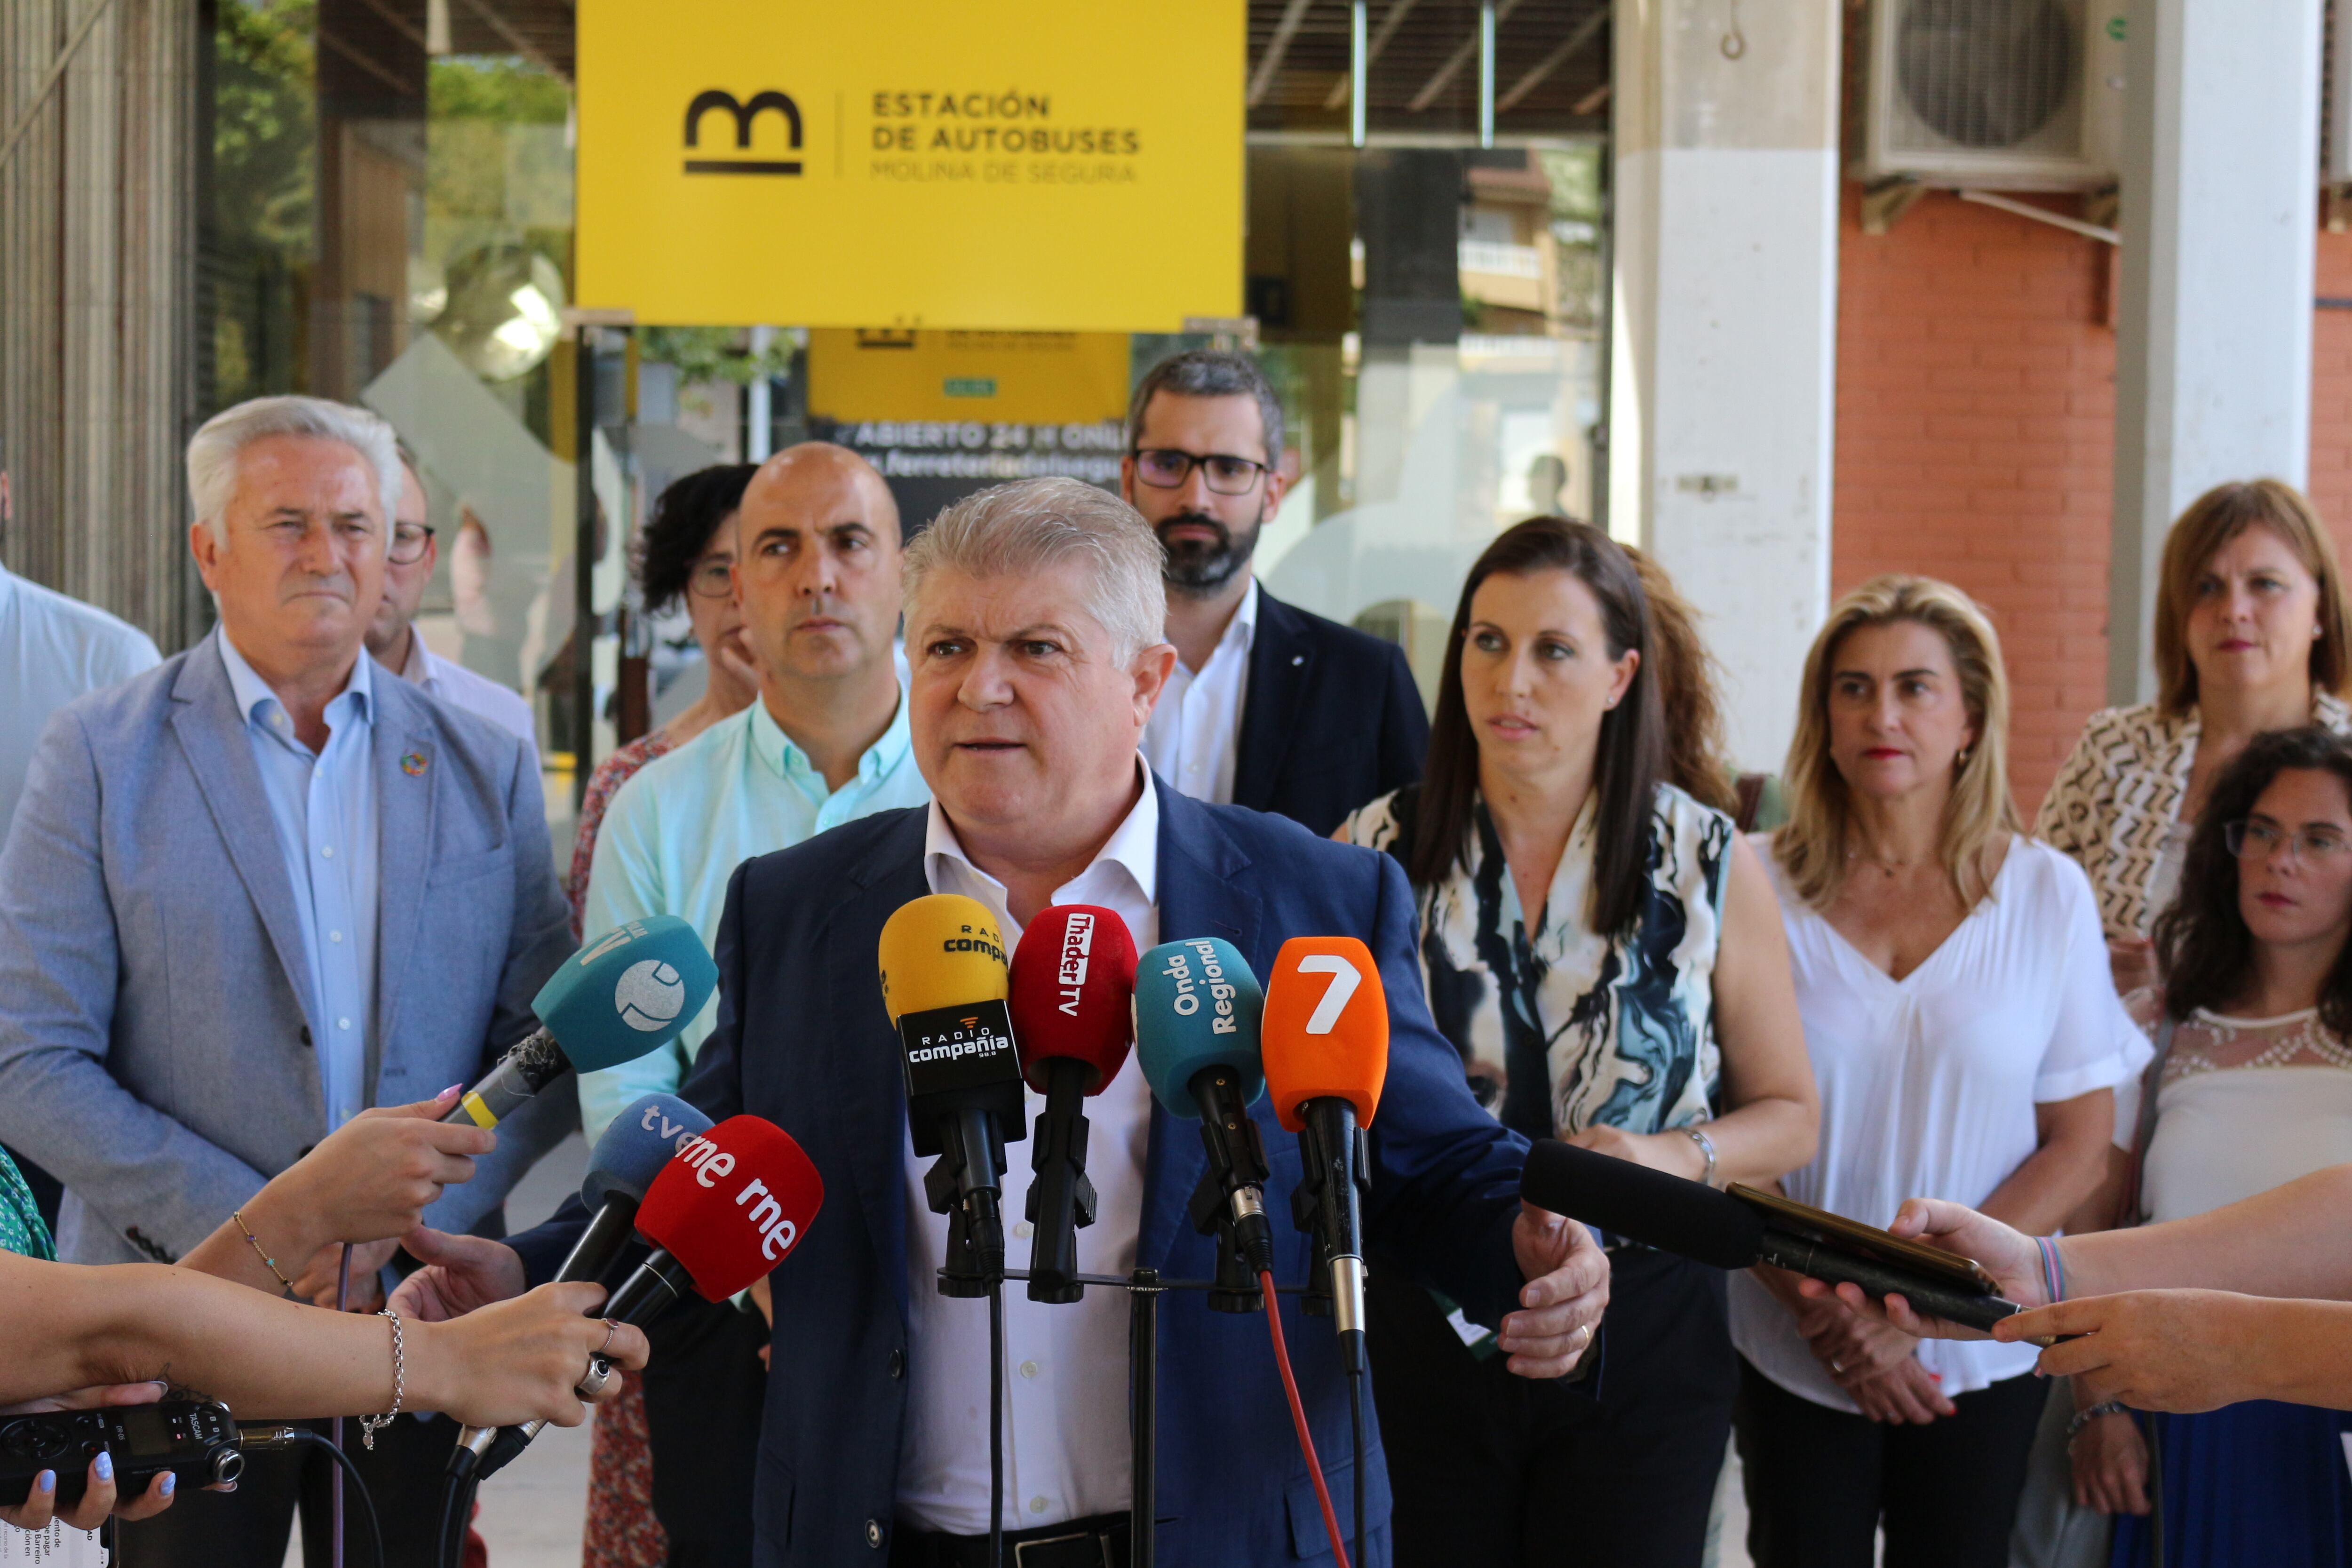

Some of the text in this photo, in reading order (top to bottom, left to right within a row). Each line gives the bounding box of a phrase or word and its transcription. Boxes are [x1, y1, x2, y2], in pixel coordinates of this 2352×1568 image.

[871, 88, 1050, 118] ESTACIÓN
[872, 127, 1140, 154] DE AUTOBUSES
[870, 162, 1136, 184] MOLINA DE SEGURA
[1162, 955, 1199, 1016] Onda
[1185, 941, 1237, 1035] Regional
[1297, 955, 1361, 1035] 7
[1058, 987, 1081, 1017] TV
[909, 1035, 1009, 1063] compañía
[922, 1027, 990, 1045] RADIO
[675, 1136, 735, 1188] rne
[735, 1178, 796, 1261] rne
[190, 1413, 203, 1440] TASCAM
[25, 1547, 30, 1556] en
[55, 1539, 61, 1548] de
